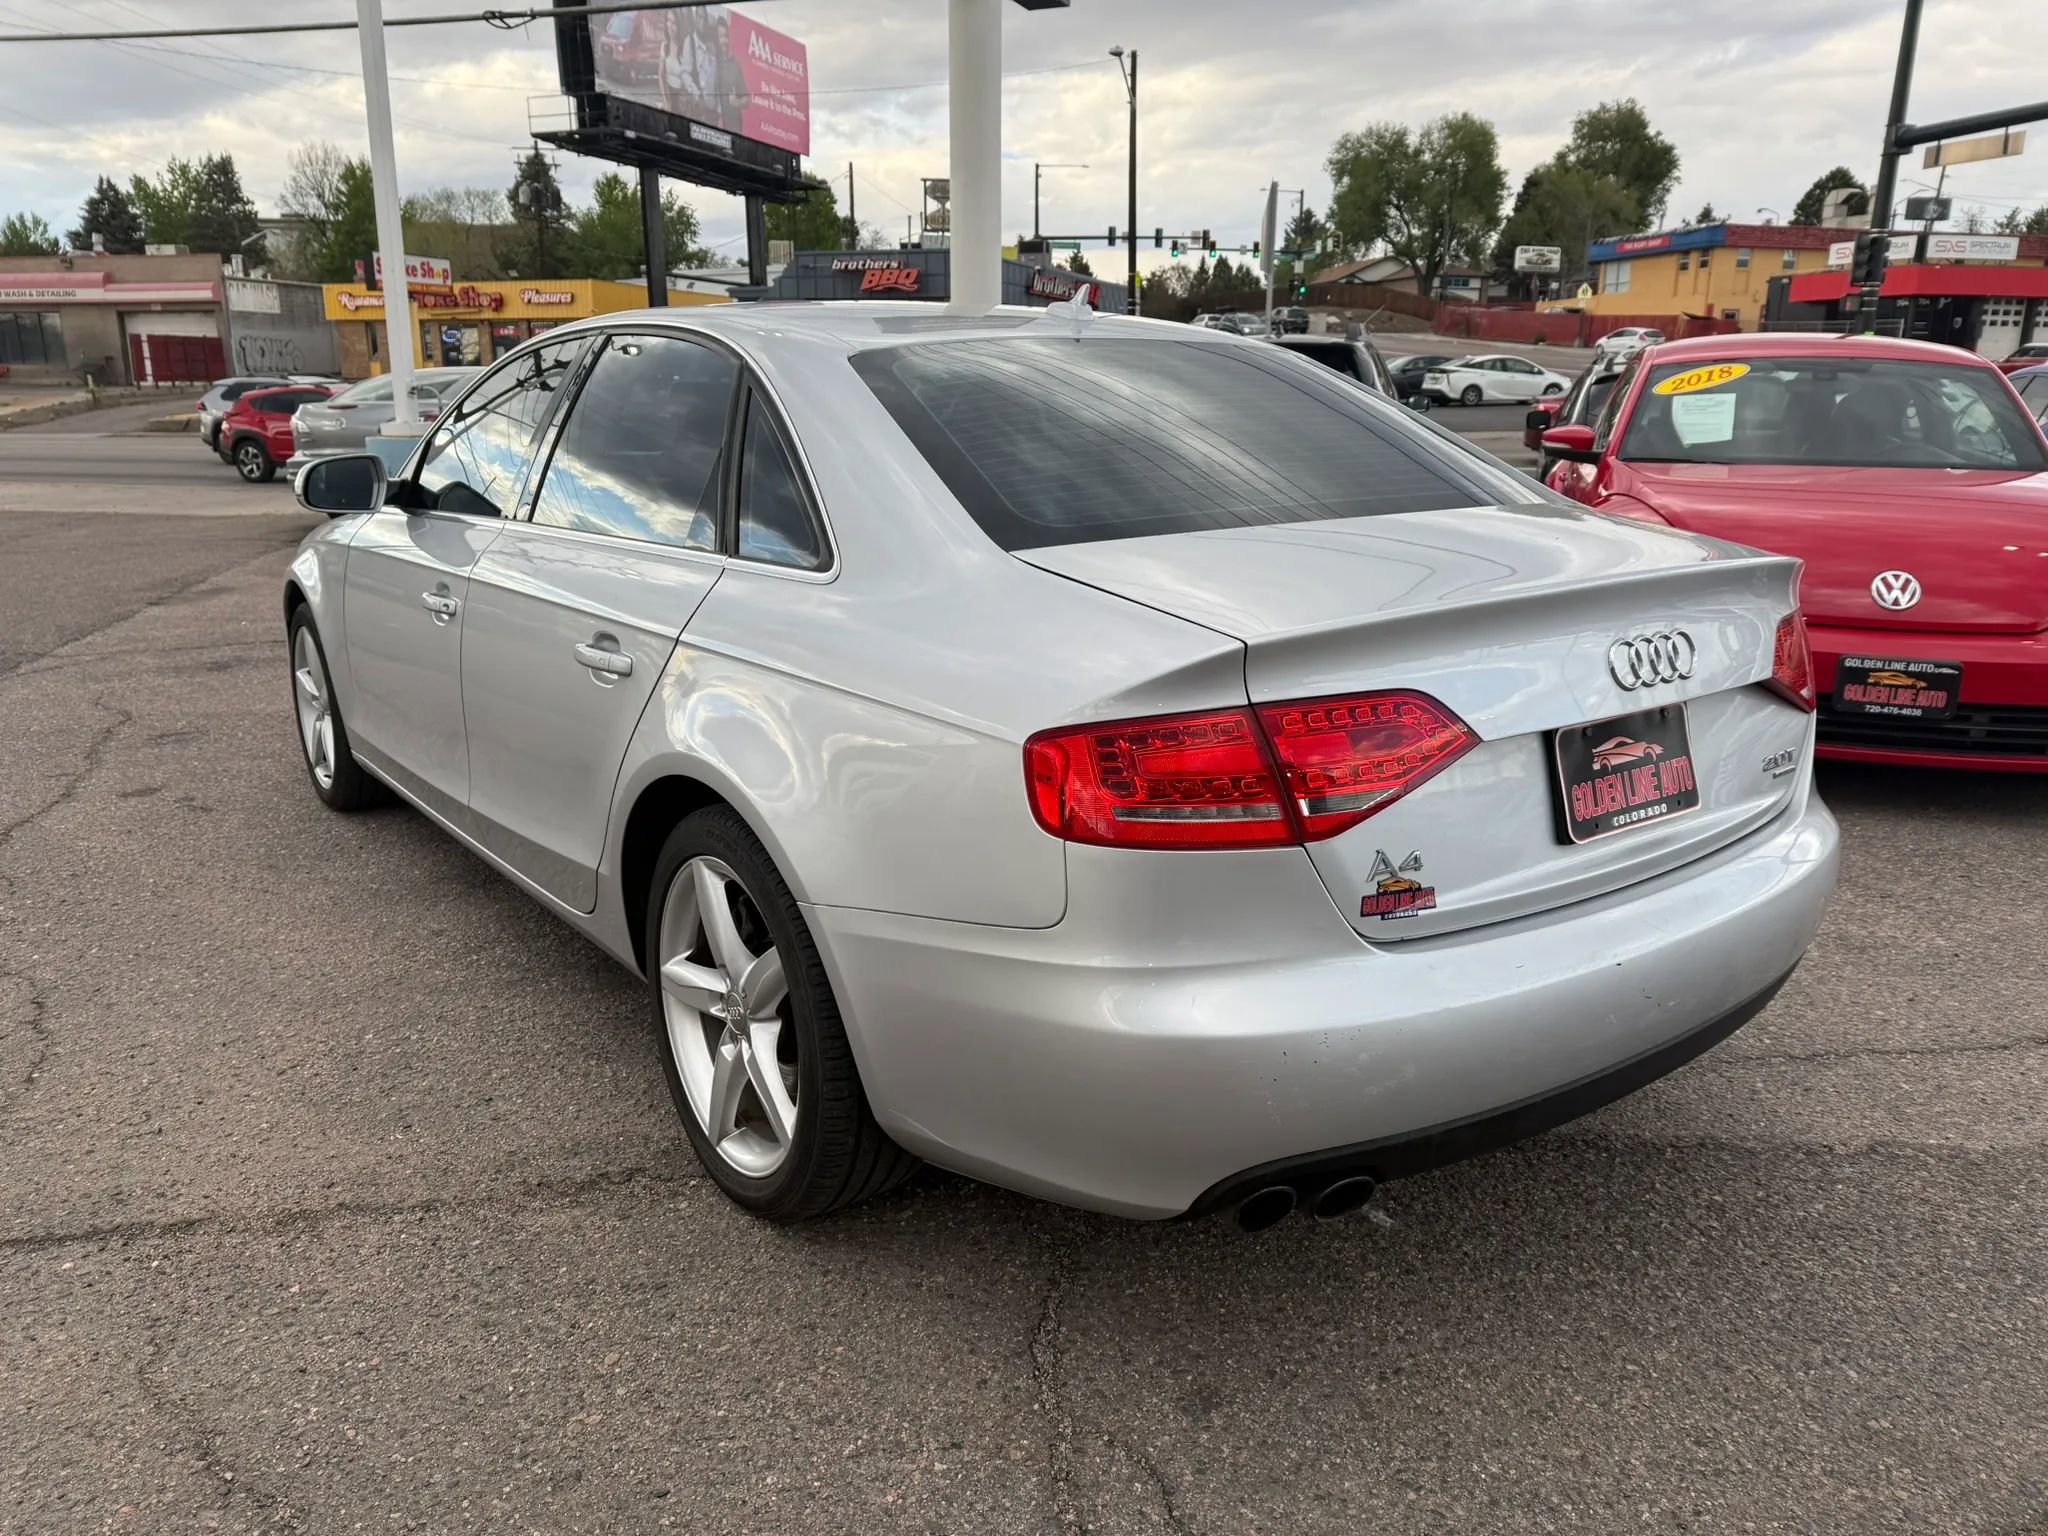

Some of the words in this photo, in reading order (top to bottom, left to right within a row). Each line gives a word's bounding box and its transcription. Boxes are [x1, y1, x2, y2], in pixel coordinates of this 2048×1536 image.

[773, 51, 804, 77] SERVICE
[1970, 241, 2012, 249] SPECTRUM
[832, 258, 899, 271] brothers
[860, 269, 920, 291] BBQ
[4, 290, 27, 298] WASH
[35, 290, 77, 298] DETAILING
[520, 289, 574, 305] Pleasures
[1671, 365, 1734, 392] 2018
[1844, 657, 1884, 669] GOLDEN
[1884, 660, 1907, 671] LINE
[1908, 663, 1935, 673] AUTO
[1843, 683, 1889, 704] GOLDEN
[1889, 687, 1916, 706] LINE
[1916, 690, 1948, 708] AUTO
[1571, 773, 1627, 822] GOLDEN
[1626, 764, 1661, 806] LINE
[1661, 755, 1694, 796] AUTO
[1613, 803, 1668, 827] COLORADO
[1366, 849, 1423, 882] A4
